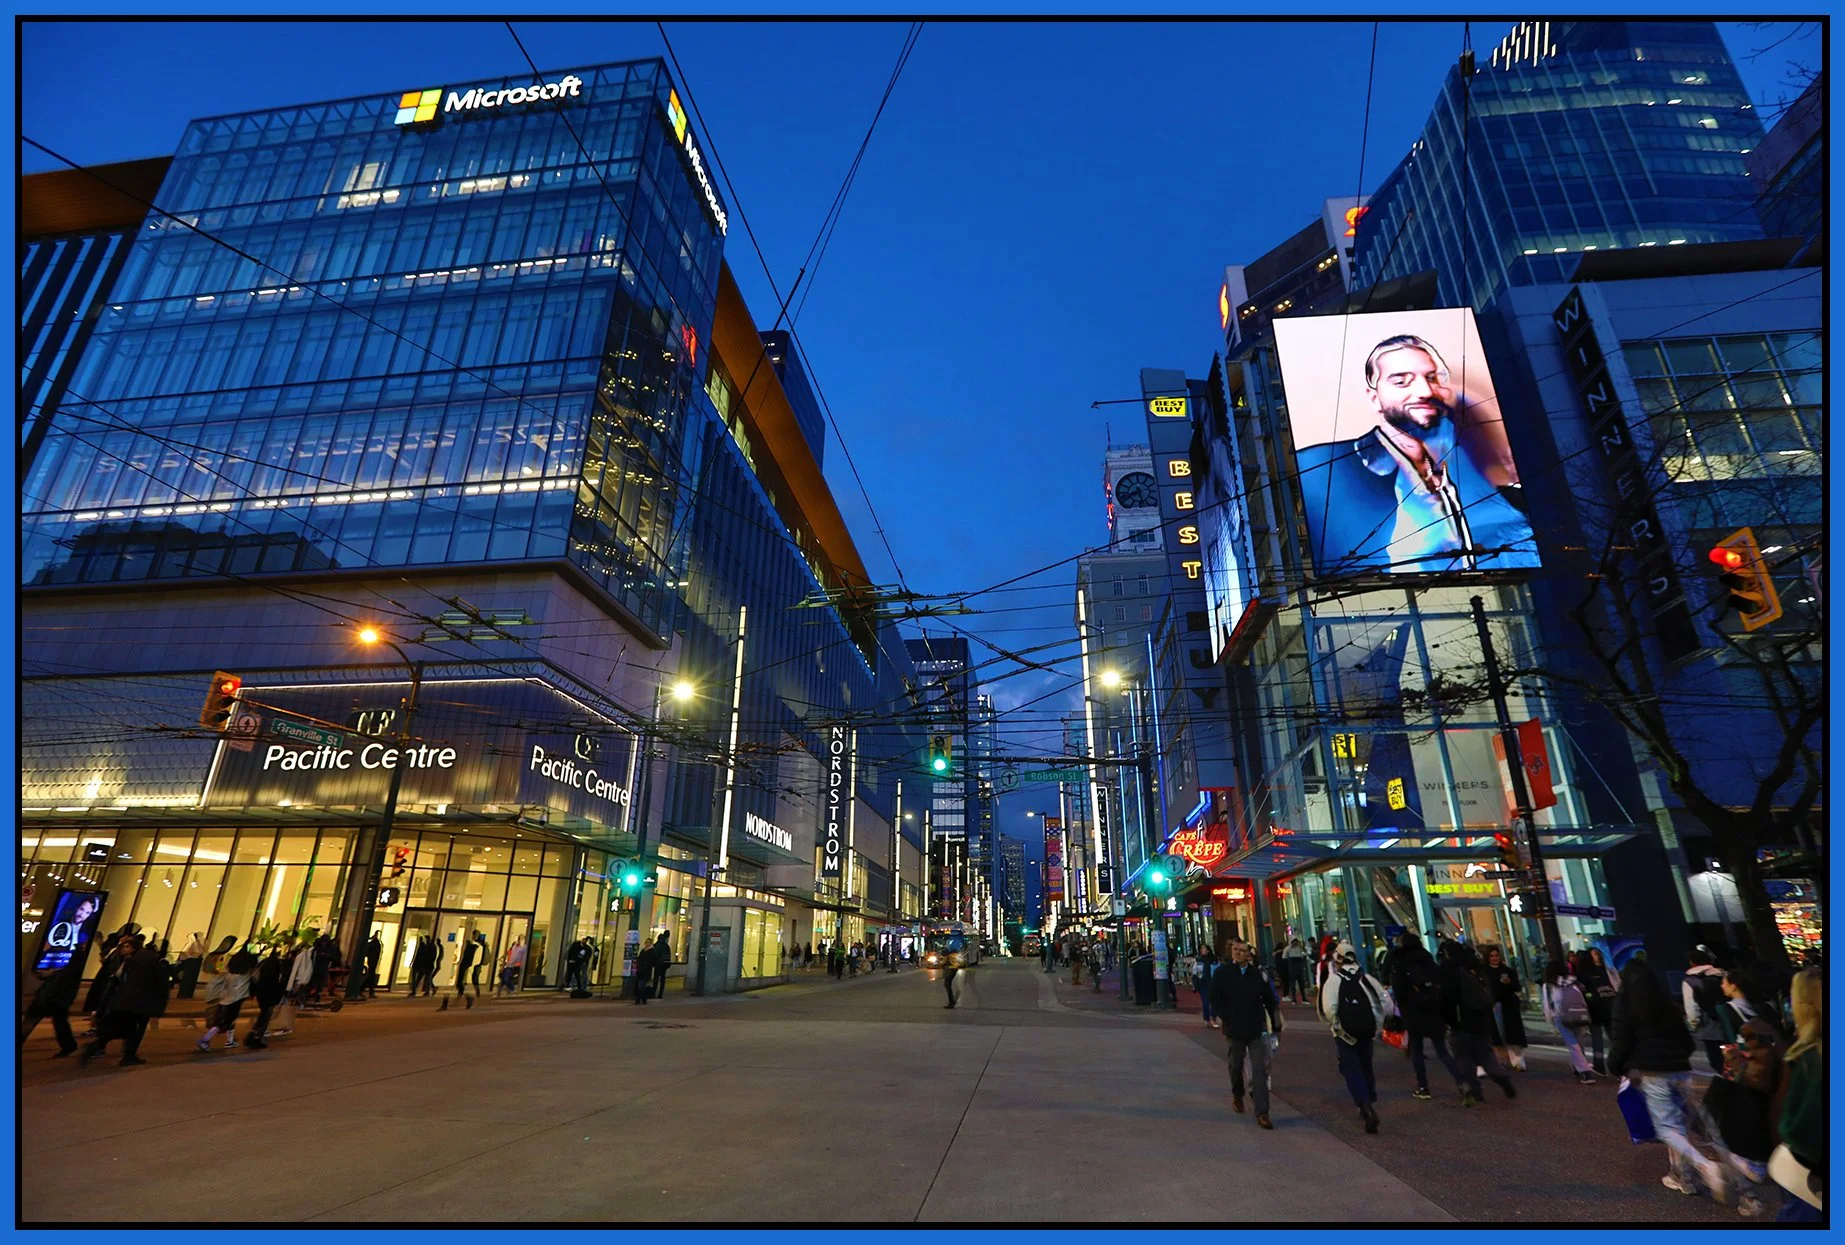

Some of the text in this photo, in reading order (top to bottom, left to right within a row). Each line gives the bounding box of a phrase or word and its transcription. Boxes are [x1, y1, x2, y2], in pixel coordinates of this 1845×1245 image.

[444, 75, 582, 113] Microsoft
[685, 132, 728, 237] Microsoft
[1169, 460, 1201, 579] BEST
[277, 722, 338, 746] Granville St
[263, 743, 456, 770] Pacific Centre
[530, 744, 582, 789] Pacific
[585, 769, 630, 807] Centre
[1031, 772, 1064, 781] Robson
[1423, 780, 1490, 791] WINERS
[825, 726, 844, 870] NORDSTROM
[745, 812, 792, 852] NORDSTROM
[1169, 840, 1223, 864] CRÊPE
[1426, 883, 1495, 893] BEST BUY
